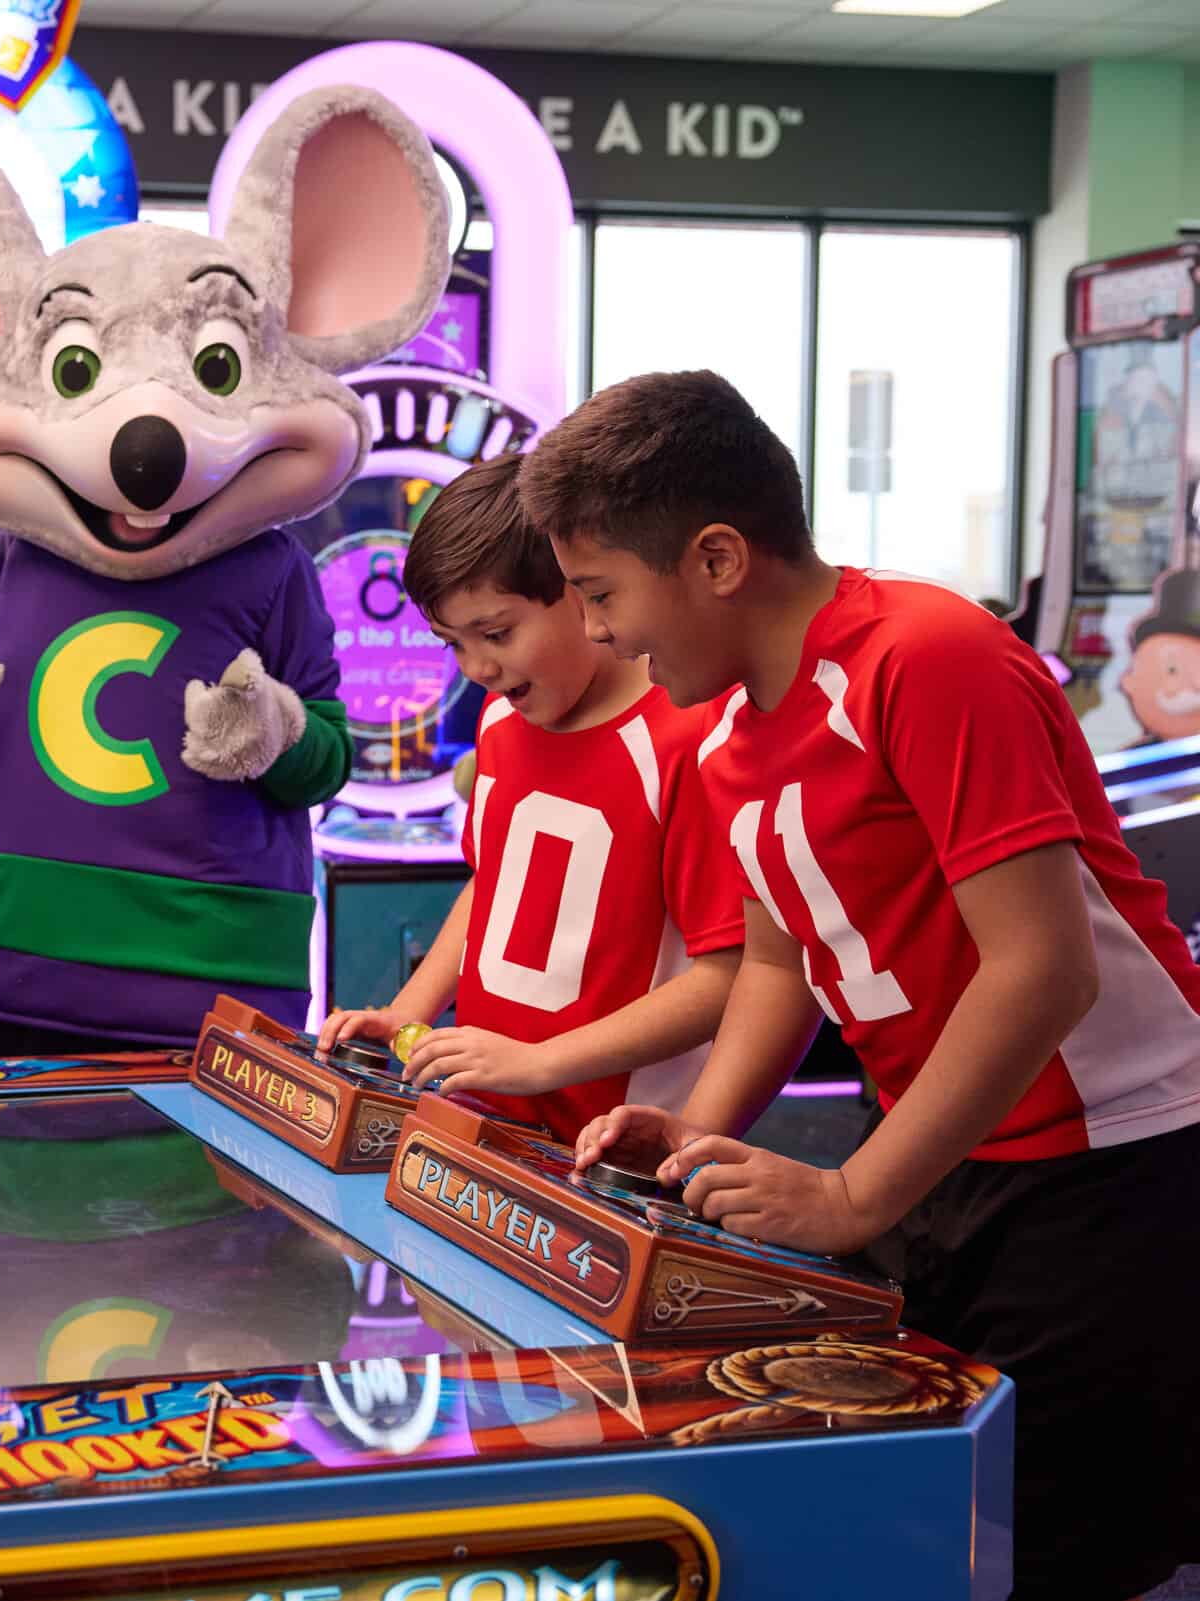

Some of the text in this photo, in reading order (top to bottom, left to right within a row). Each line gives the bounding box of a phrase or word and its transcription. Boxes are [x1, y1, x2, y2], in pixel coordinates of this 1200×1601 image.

[172, 79, 271, 136] KI
[596, 99, 643, 155] A
[28, 610, 182, 807] C
[730, 781, 913, 1025] 11
[211, 1044, 317, 1121] PLAYER 3
[418, 1157, 593, 1280] PLAYER 4
